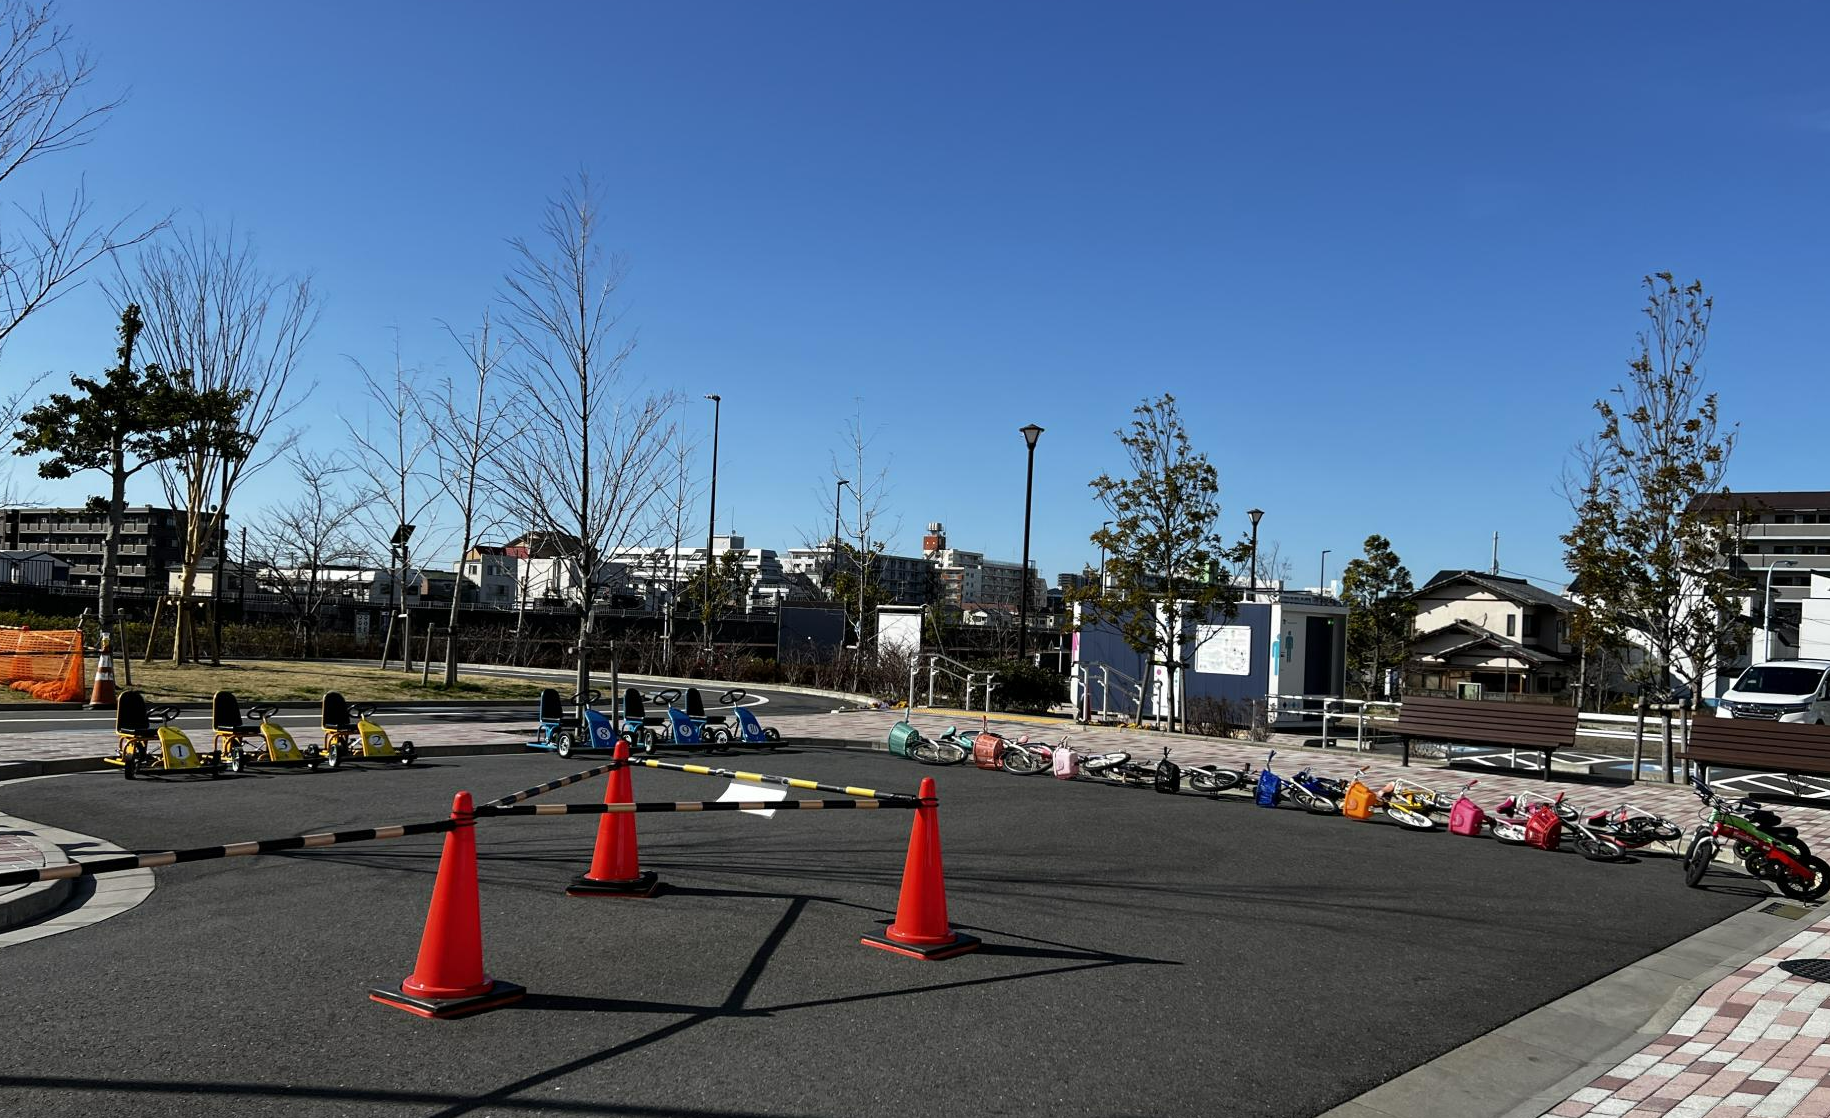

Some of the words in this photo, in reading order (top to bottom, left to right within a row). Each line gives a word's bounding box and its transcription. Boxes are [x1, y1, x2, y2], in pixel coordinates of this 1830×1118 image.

[600, 728, 608, 738] 8
[682, 725, 689, 735] 9
[279, 739, 287, 750] 3
[372, 736, 381, 746] 2
[177, 745, 183, 757] 1
